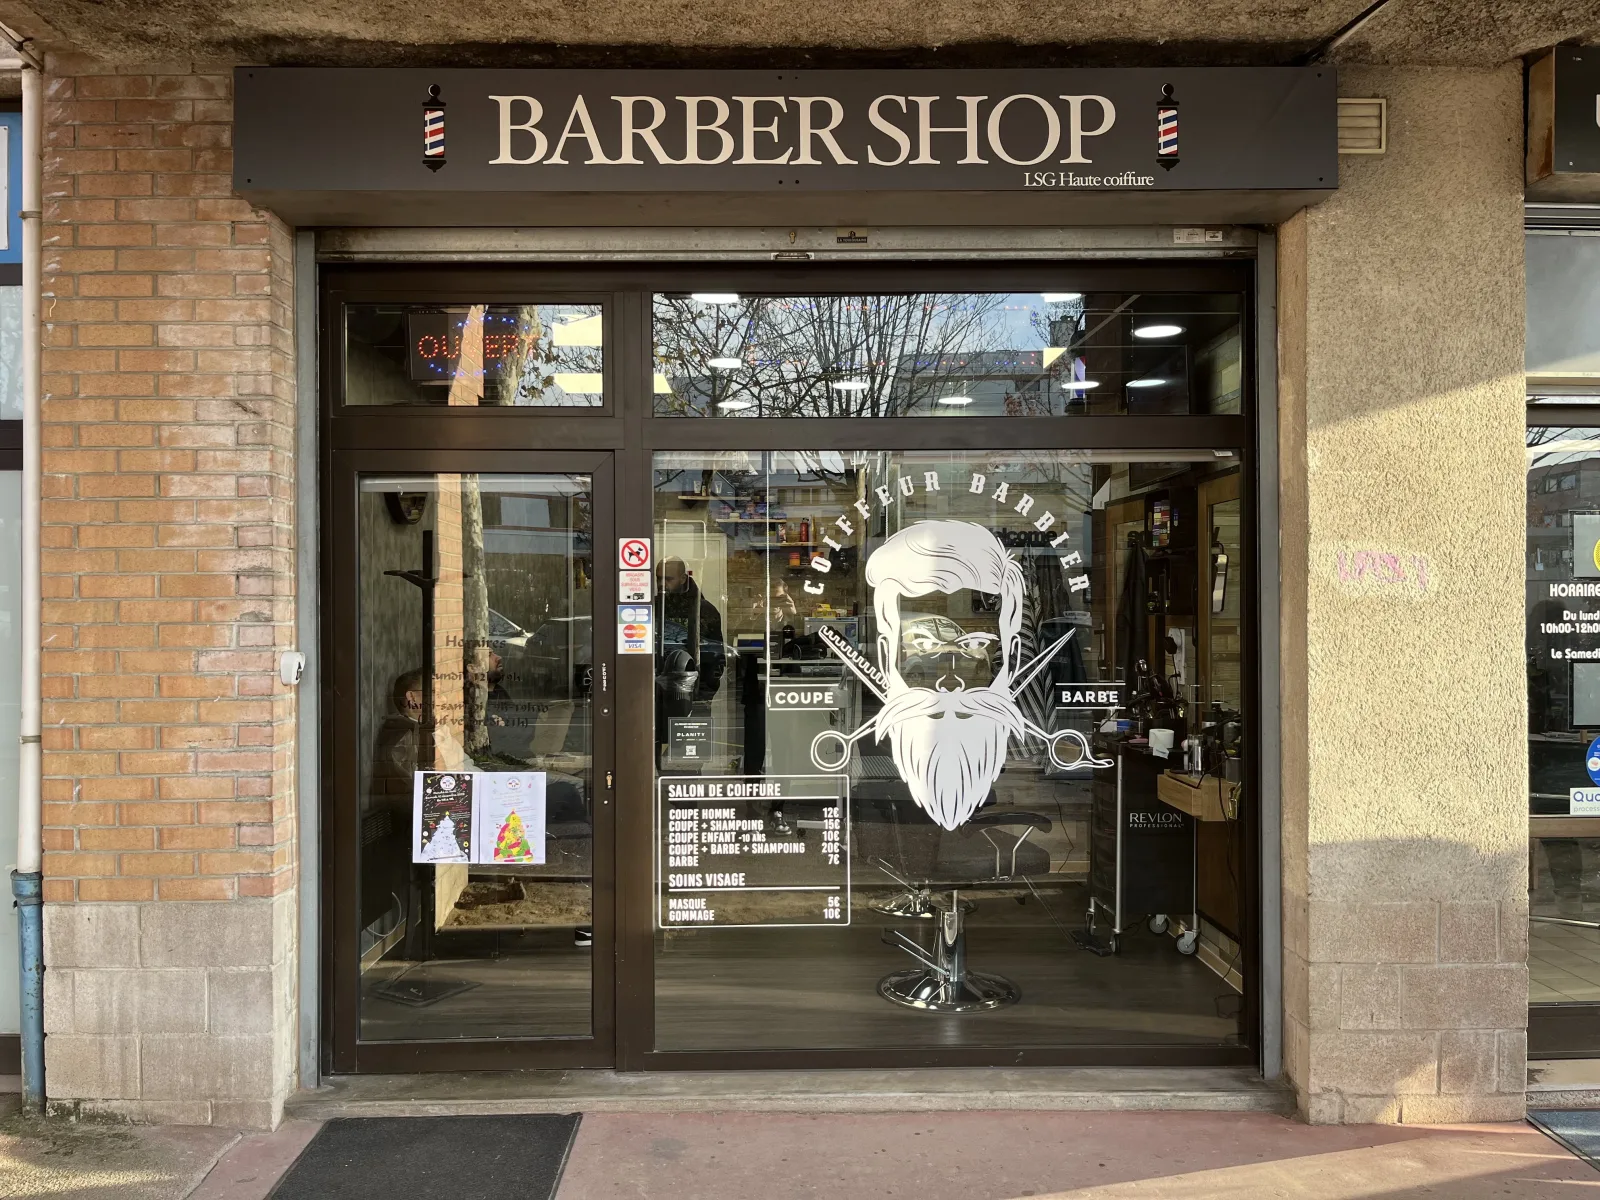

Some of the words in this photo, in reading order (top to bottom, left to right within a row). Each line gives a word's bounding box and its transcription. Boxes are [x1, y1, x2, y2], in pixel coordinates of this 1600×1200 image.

[488, 94, 858, 165] BARBER
[867, 93, 1117, 166] SHOP
[1024, 172, 1056, 187] LSG
[1058, 172, 1102, 187] Haute
[1103, 171, 1155, 187] coiffure
[418, 335, 540, 358] OUVERT
[803, 471, 941, 596] COIFFEUR
[969, 472, 1091, 594] BARBIER
[991, 528, 1058, 547] elcome
[1563, 610, 1577, 621] Du
[1540, 623, 1600, 634] 10h00-12h0
[1551, 648, 1562, 659] Le
[1565, 648, 1600, 659] Samedi
[775, 691, 834, 705] COUPE
[1062, 690, 1118, 703] BARBE
[668, 784, 704, 797] SALON
[709, 784, 723, 797] DE
[727, 783, 781, 796] COIFFURE
[669, 809, 699, 820] COUPE
[702, 809, 736, 819] HOMME
[823, 807, 839, 818] 12€
[1130, 812, 1182, 822] REVLON
[669, 821, 699, 831] COUPE
[710, 820, 764, 831] SHAMPOING
[823, 819, 840, 830] 15€
[669, 832, 699, 844] COUPE
[702, 832, 736, 843] ENFANT
[752, 834, 766, 842] ANS
[822, 831, 840, 842] 10€
[669, 844, 699, 855] COUPE
[710, 844, 740, 855] BARBE
[752, 843, 805, 854] SHAMPOING
[821, 843, 840, 853] 20€
[669, 856, 699, 867] BARBE
[828, 854, 840, 865] 7€
[668, 874, 702, 887] SOINS
[706, 873, 745, 886] VISAGE
[669, 899, 706, 910] MASQUE
[828, 897, 840, 907] 5€
[669, 910, 714, 921] GOMMAGE
[823, 909, 840, 919] 10€
